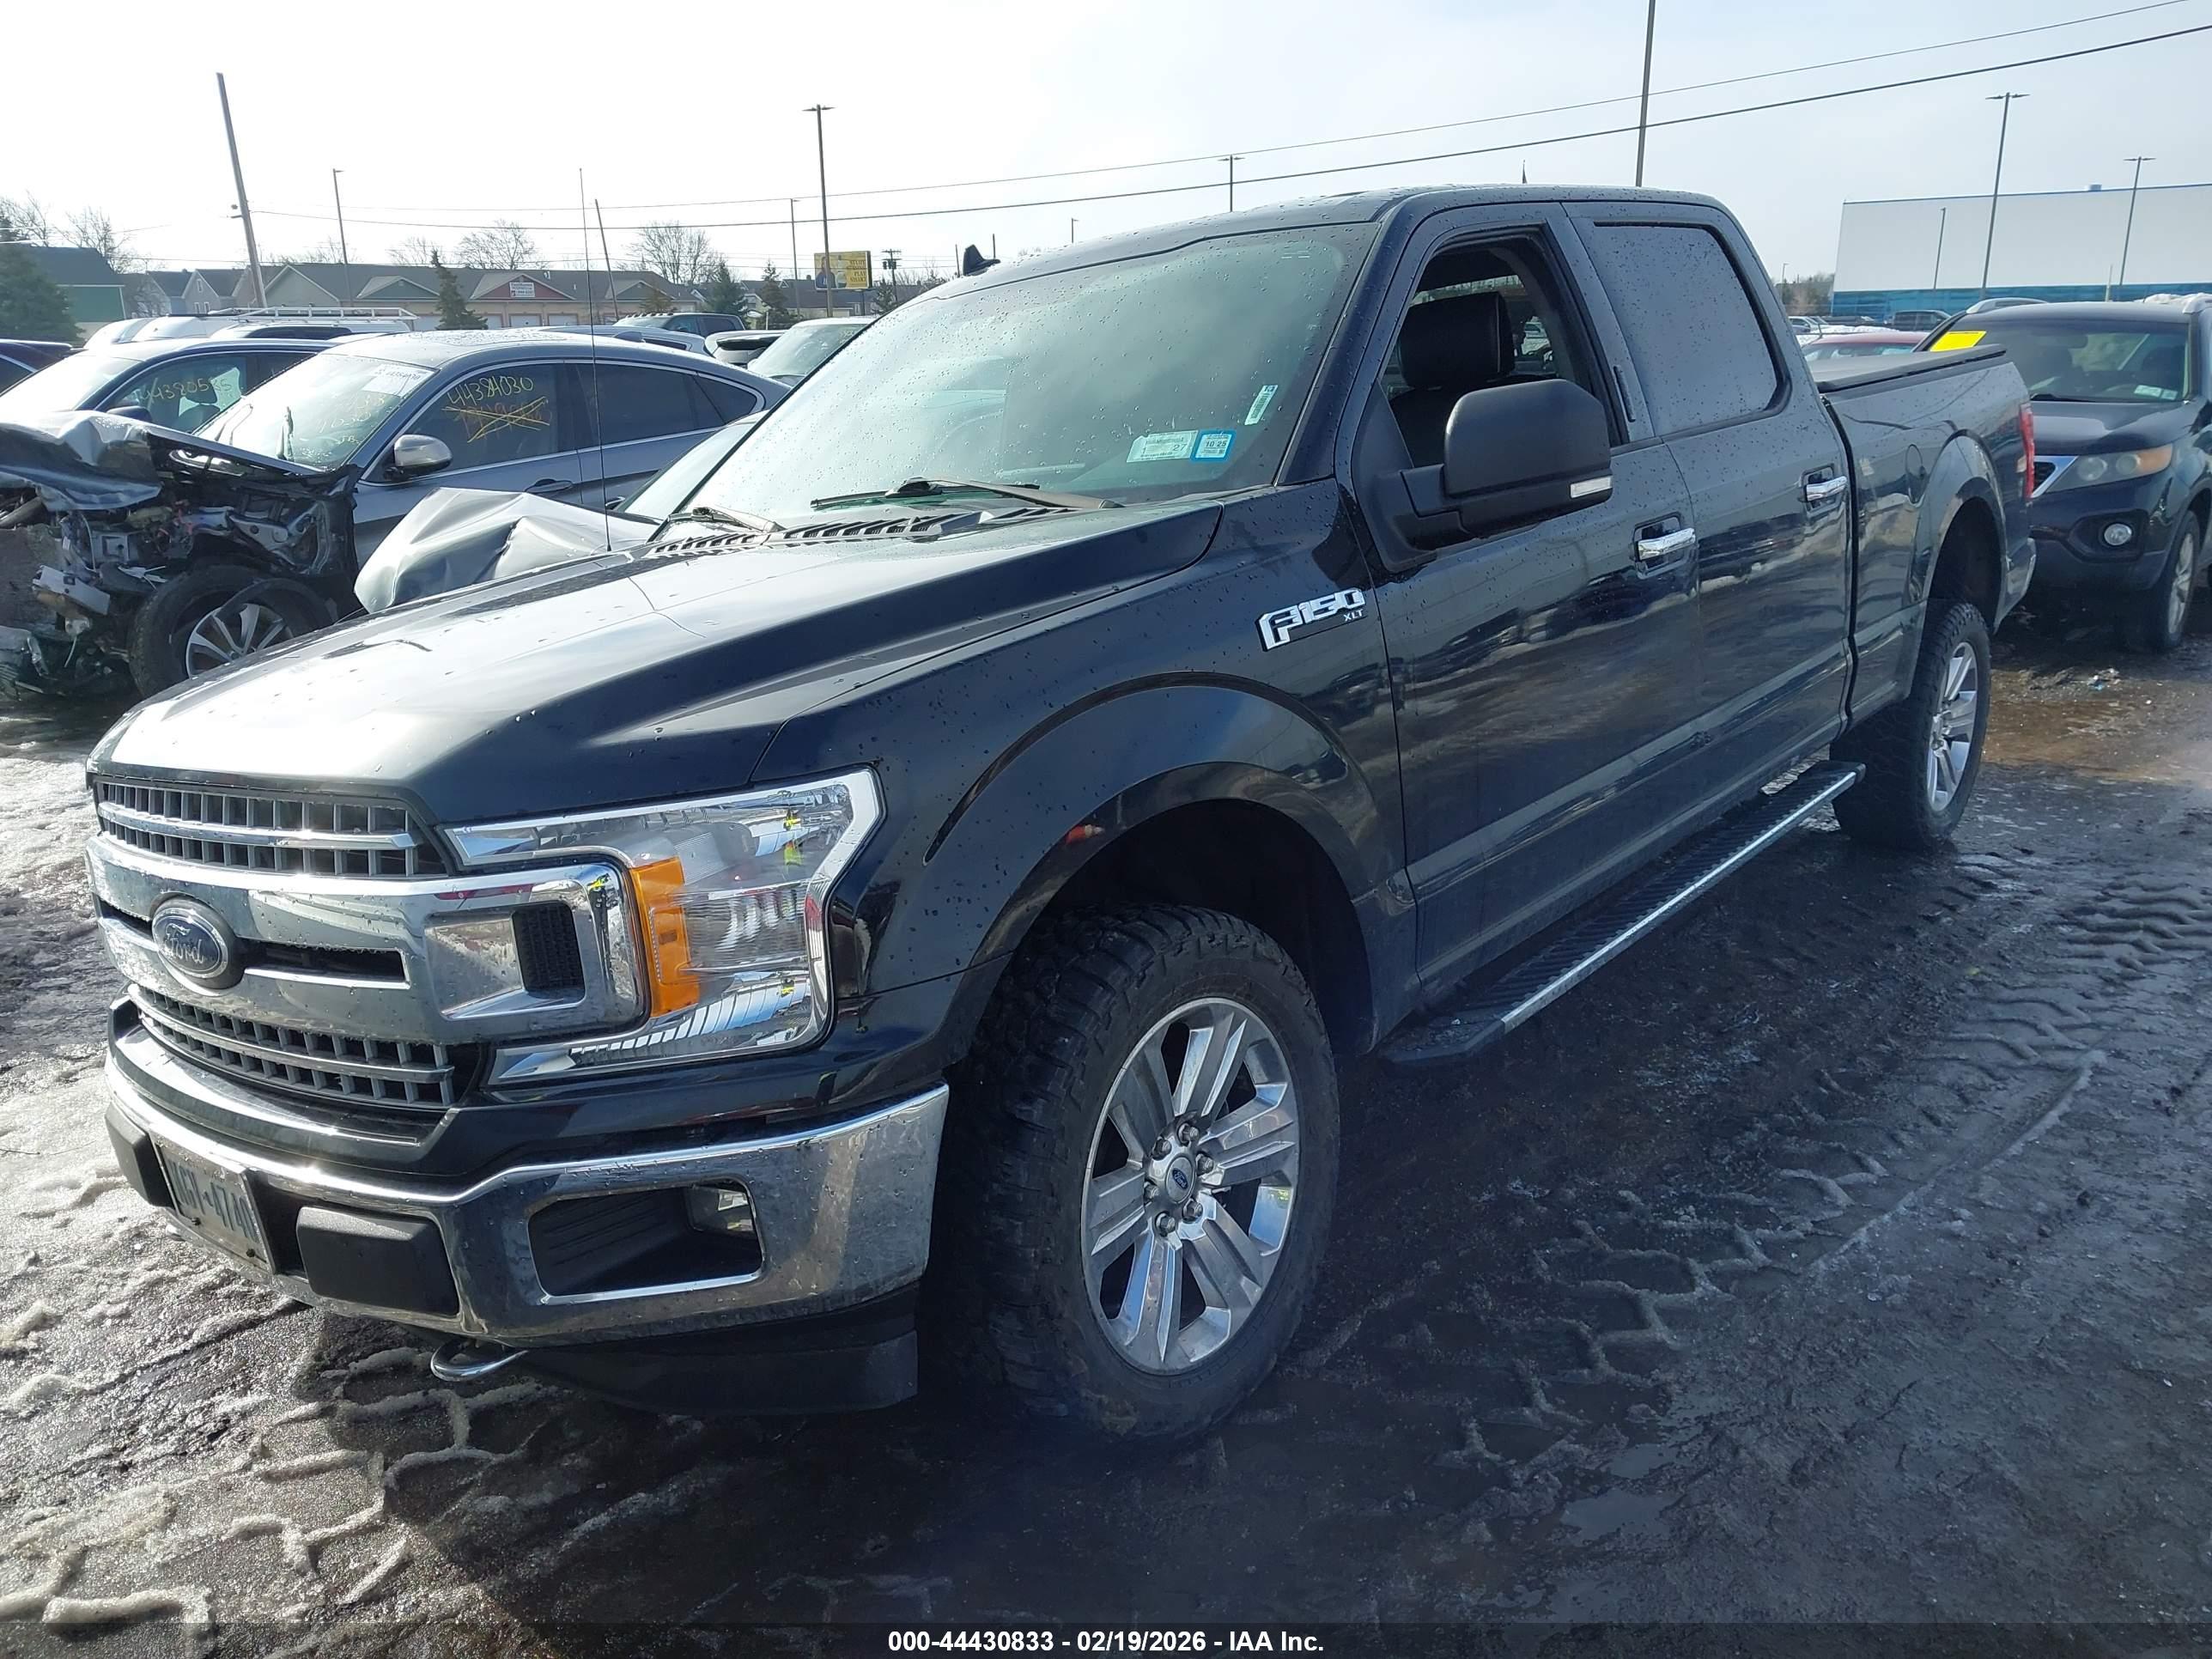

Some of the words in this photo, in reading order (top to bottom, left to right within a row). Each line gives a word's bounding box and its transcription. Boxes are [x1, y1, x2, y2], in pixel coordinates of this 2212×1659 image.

[447, 375, 533, 405] 44384030
[1172, 443, 1188, 452] 27
[1343, 608, 1364, 622] XLT
[163, 922, 206, 964] Ford
